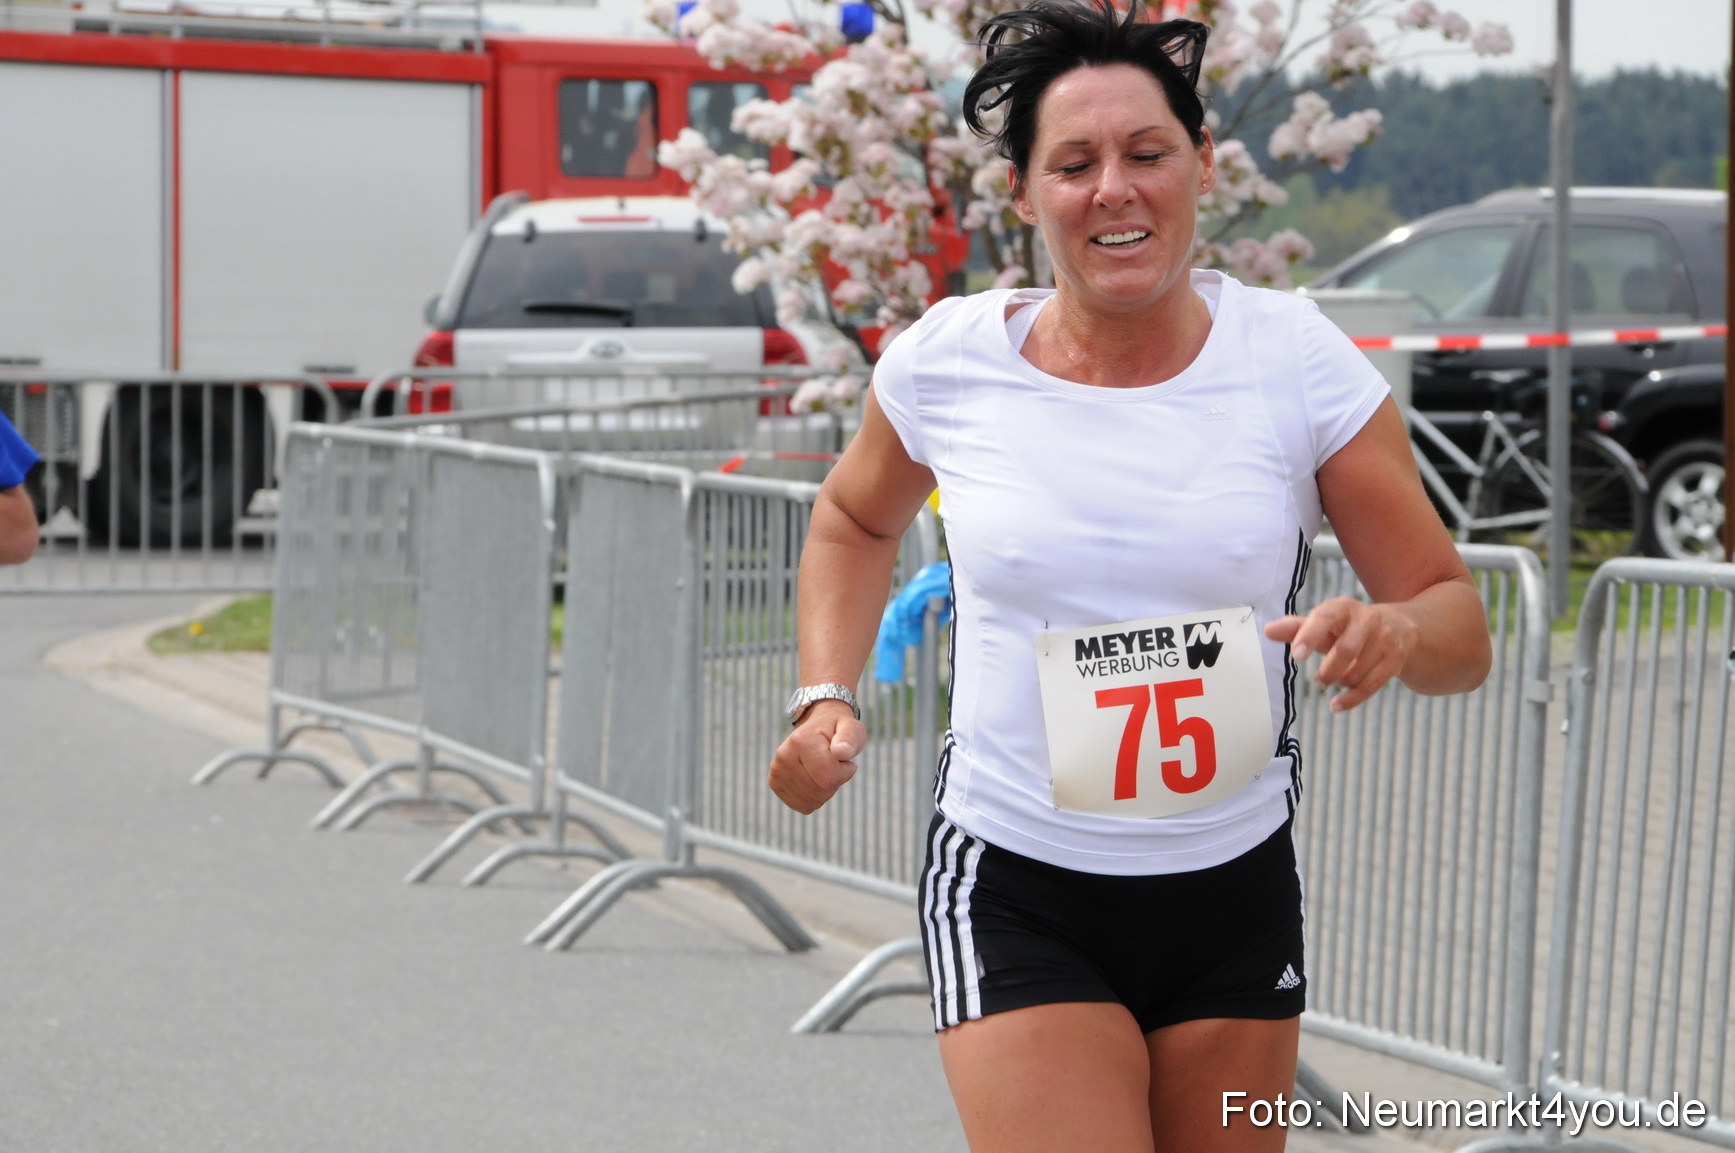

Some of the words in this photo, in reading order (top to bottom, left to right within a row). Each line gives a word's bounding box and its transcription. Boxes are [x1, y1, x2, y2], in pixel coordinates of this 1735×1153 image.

[1075, 627, 1177, 661] MEYER
[1076, 652, 1179, 678] WERBUNG
[1095, 678, 1217, 801] 75
